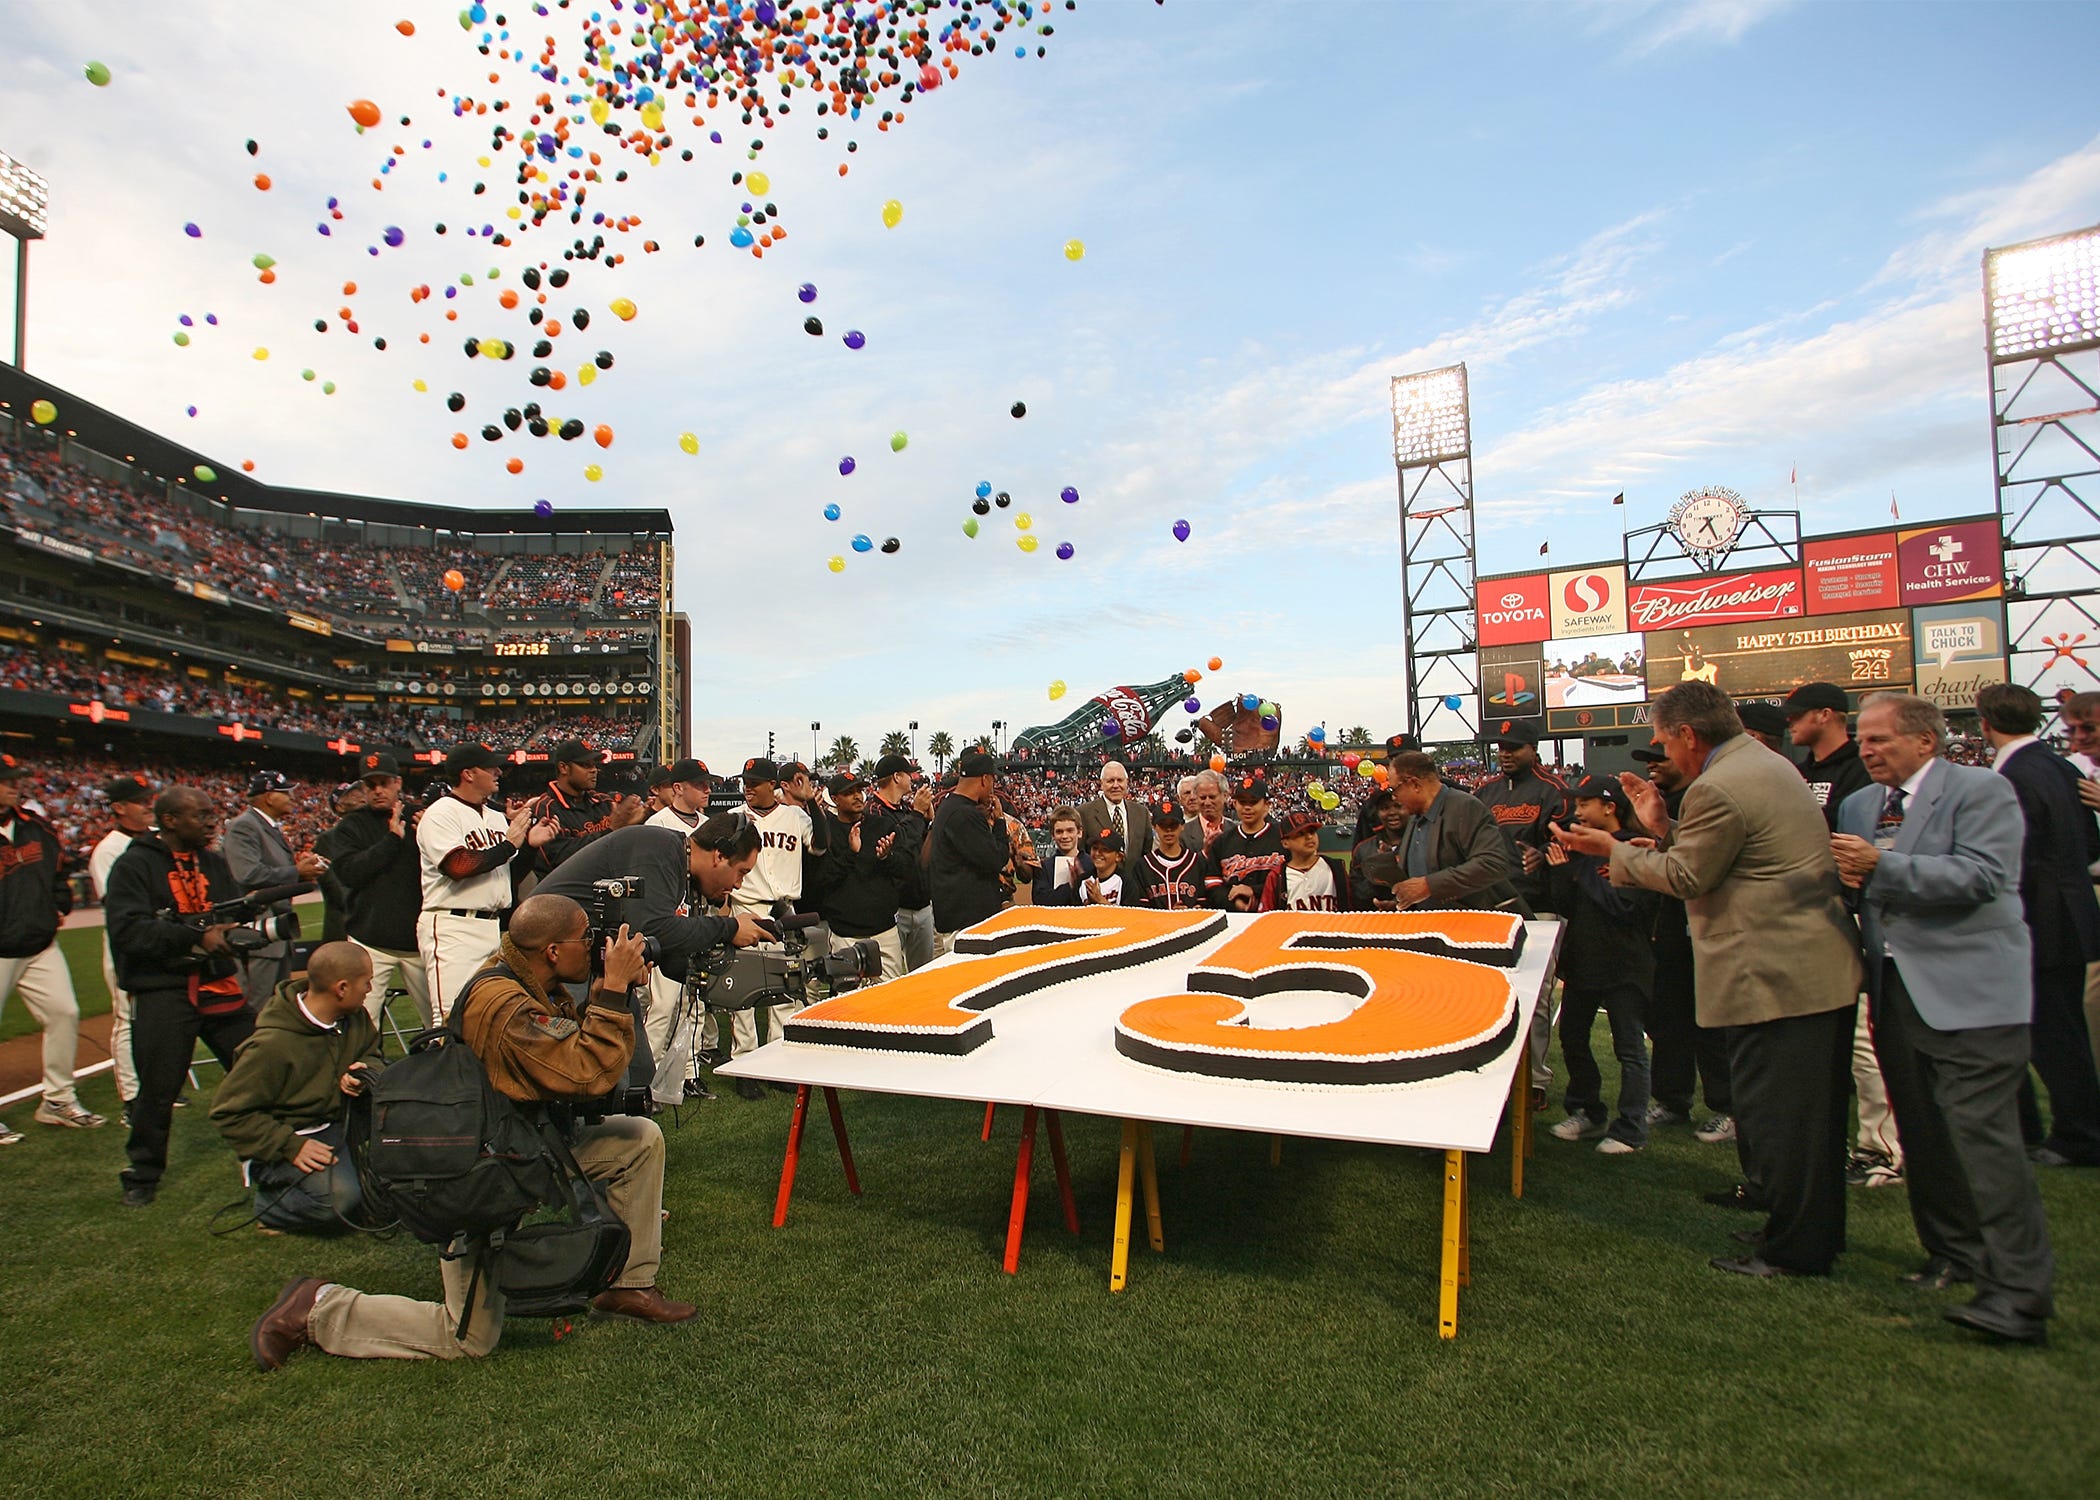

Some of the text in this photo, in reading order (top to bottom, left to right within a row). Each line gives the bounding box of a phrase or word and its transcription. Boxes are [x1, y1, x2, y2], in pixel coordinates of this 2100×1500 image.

[1808, 552, 1892, 568] FusionStorm
[1923, 561, 1971, 578] CHW
[1906, 575, 1991, 591] Health Services
[1631, 581, 1796, 625] Budweiser
[1482, 607, 1545, 625] TOYOTA
[1564, 614, 1612, 627] SAFEWAY
[1737, 622, 1904, 650] HAPPY 75TH BIRTHDAY
[1930, 626, 1975, 637] TALK TO
[494, 643, 549, 656] 7:27:52
[1931, 636, 1975, 649] CHUCK
[1848, 649, 1892, 660] MAYS
[1851, 659, 1889, 680] 24
[612, 752, 635, 760] GIANTS
[725, 976, 734, 990] 9
[783, 906, 1527, 1089] 75
